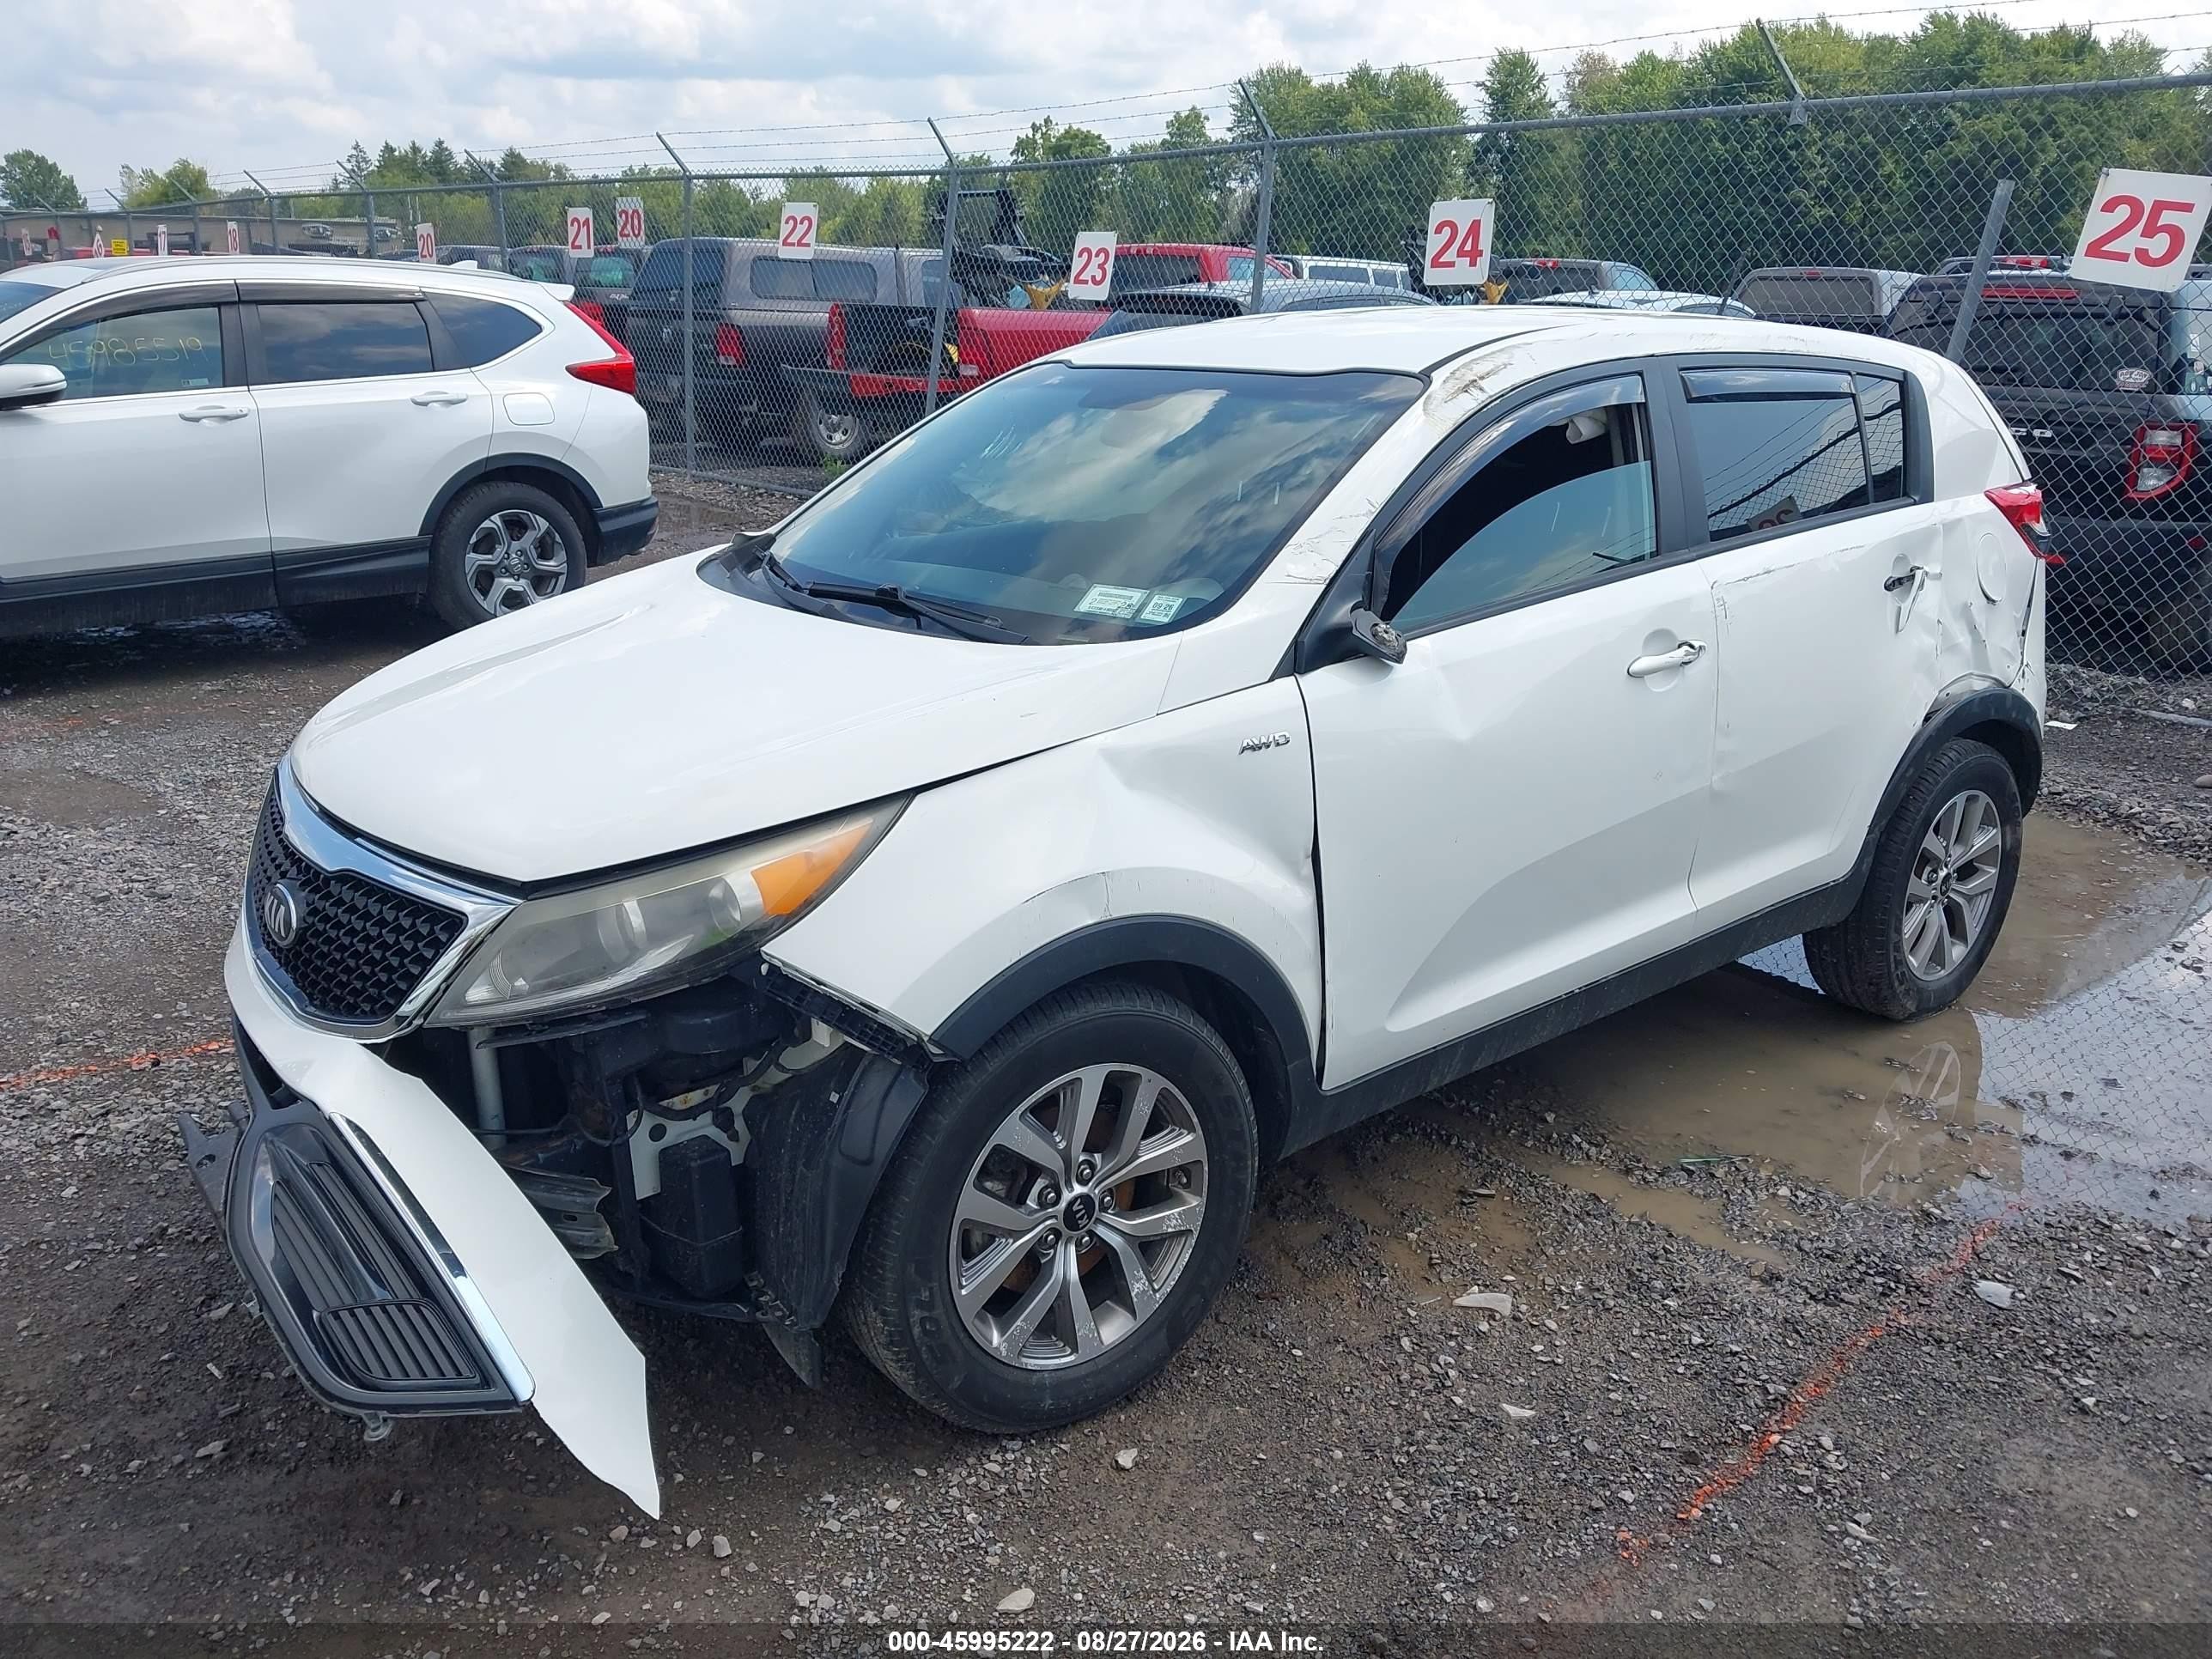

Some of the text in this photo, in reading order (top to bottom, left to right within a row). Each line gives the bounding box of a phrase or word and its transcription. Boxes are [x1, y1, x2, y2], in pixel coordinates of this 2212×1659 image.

[228, 228, 239, 252] 18
[569, 216, 592, 250] 21
[618, 208, 642, 239] 20
[781, 215, 813, 248] 22
[2084, 194, 2196, 268] 25
[159, 230, 167, 252] 17
[418, 233, 434, 258] 20
[1430, 218, 1484, 269] 24
[1073, 246, 1110, 287] 23
[48, 337, 210, 370] 45985519
[1237, 731, 1291, 756] AWD
